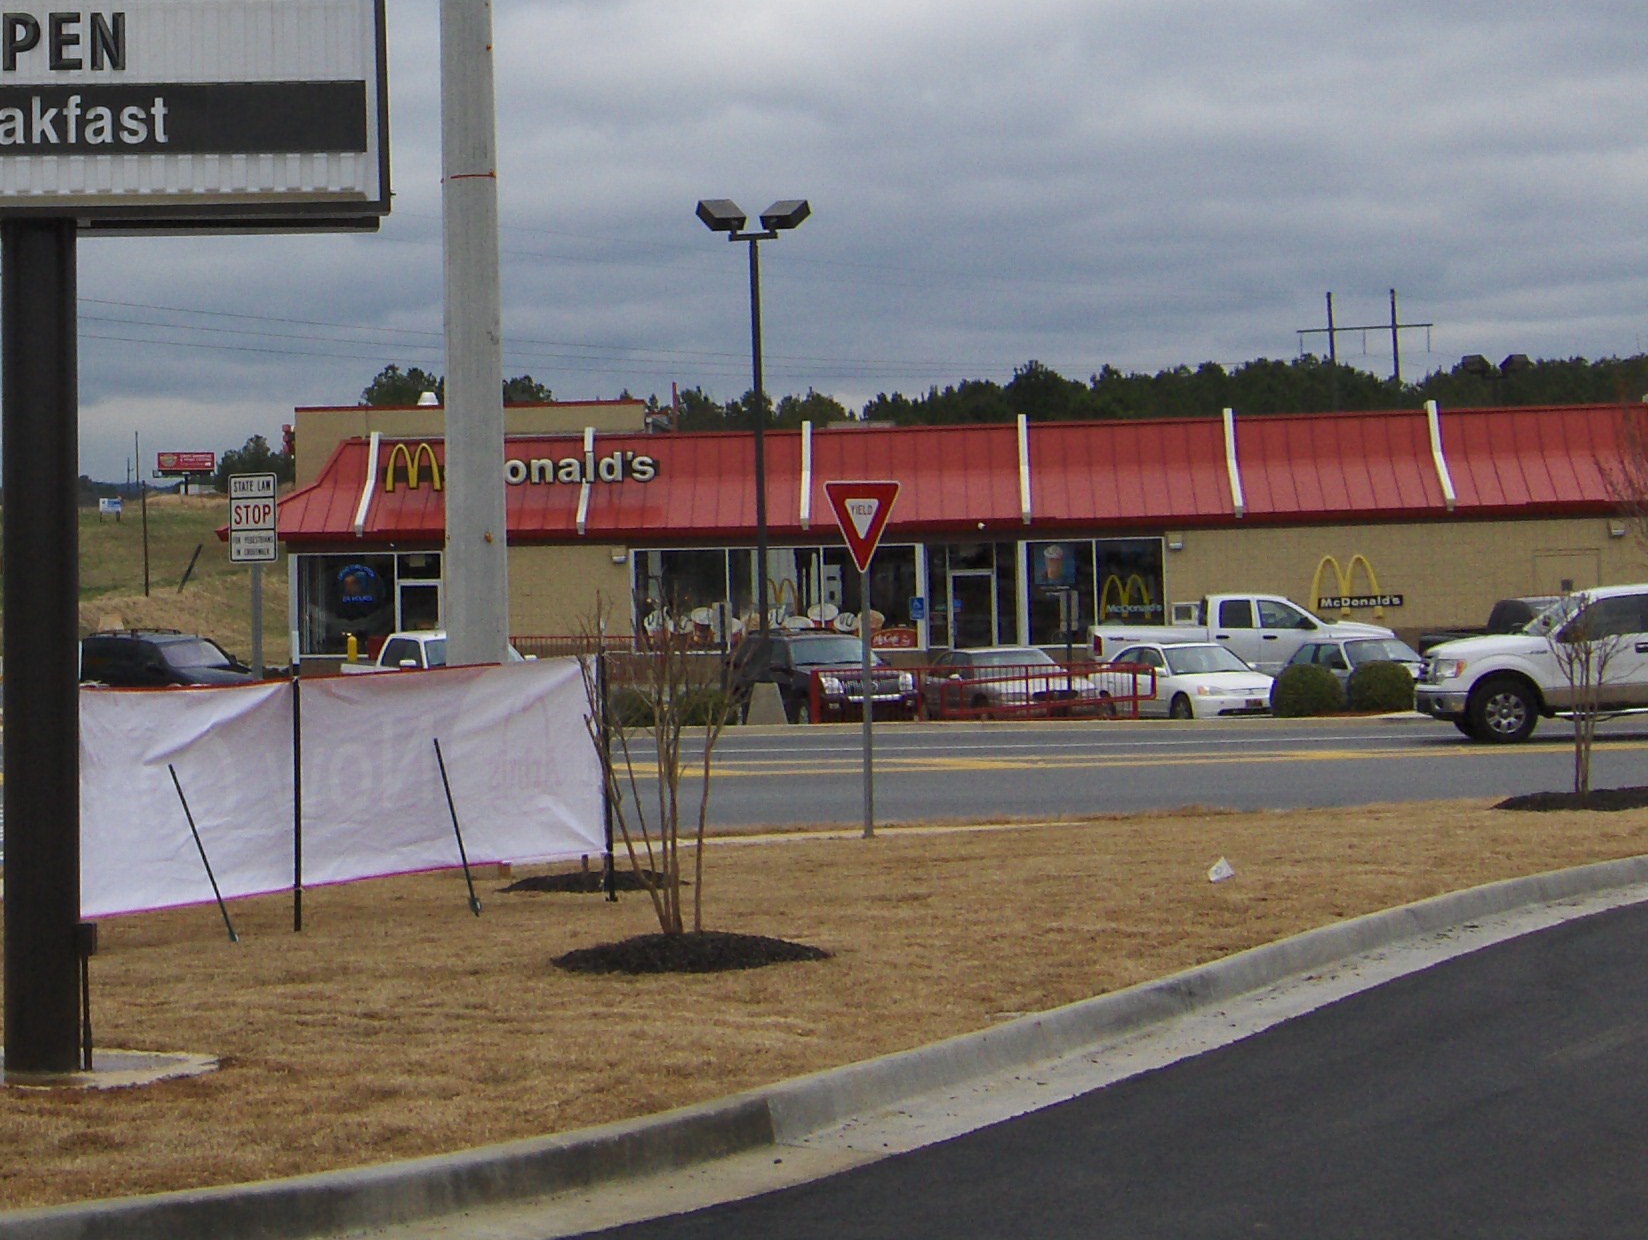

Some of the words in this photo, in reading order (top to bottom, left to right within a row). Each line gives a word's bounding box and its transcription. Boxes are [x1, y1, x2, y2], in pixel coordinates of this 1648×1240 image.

[233, 480, 253, 493] STATE
[257, 480, 271, 492] LAW
[234, 503, 271, 525] STOP
[851, 504, 873, 515] YIELD
[1320, 595, 1401, 608] McDonald's
[1106, 604, 1163, 614] McDonald's
